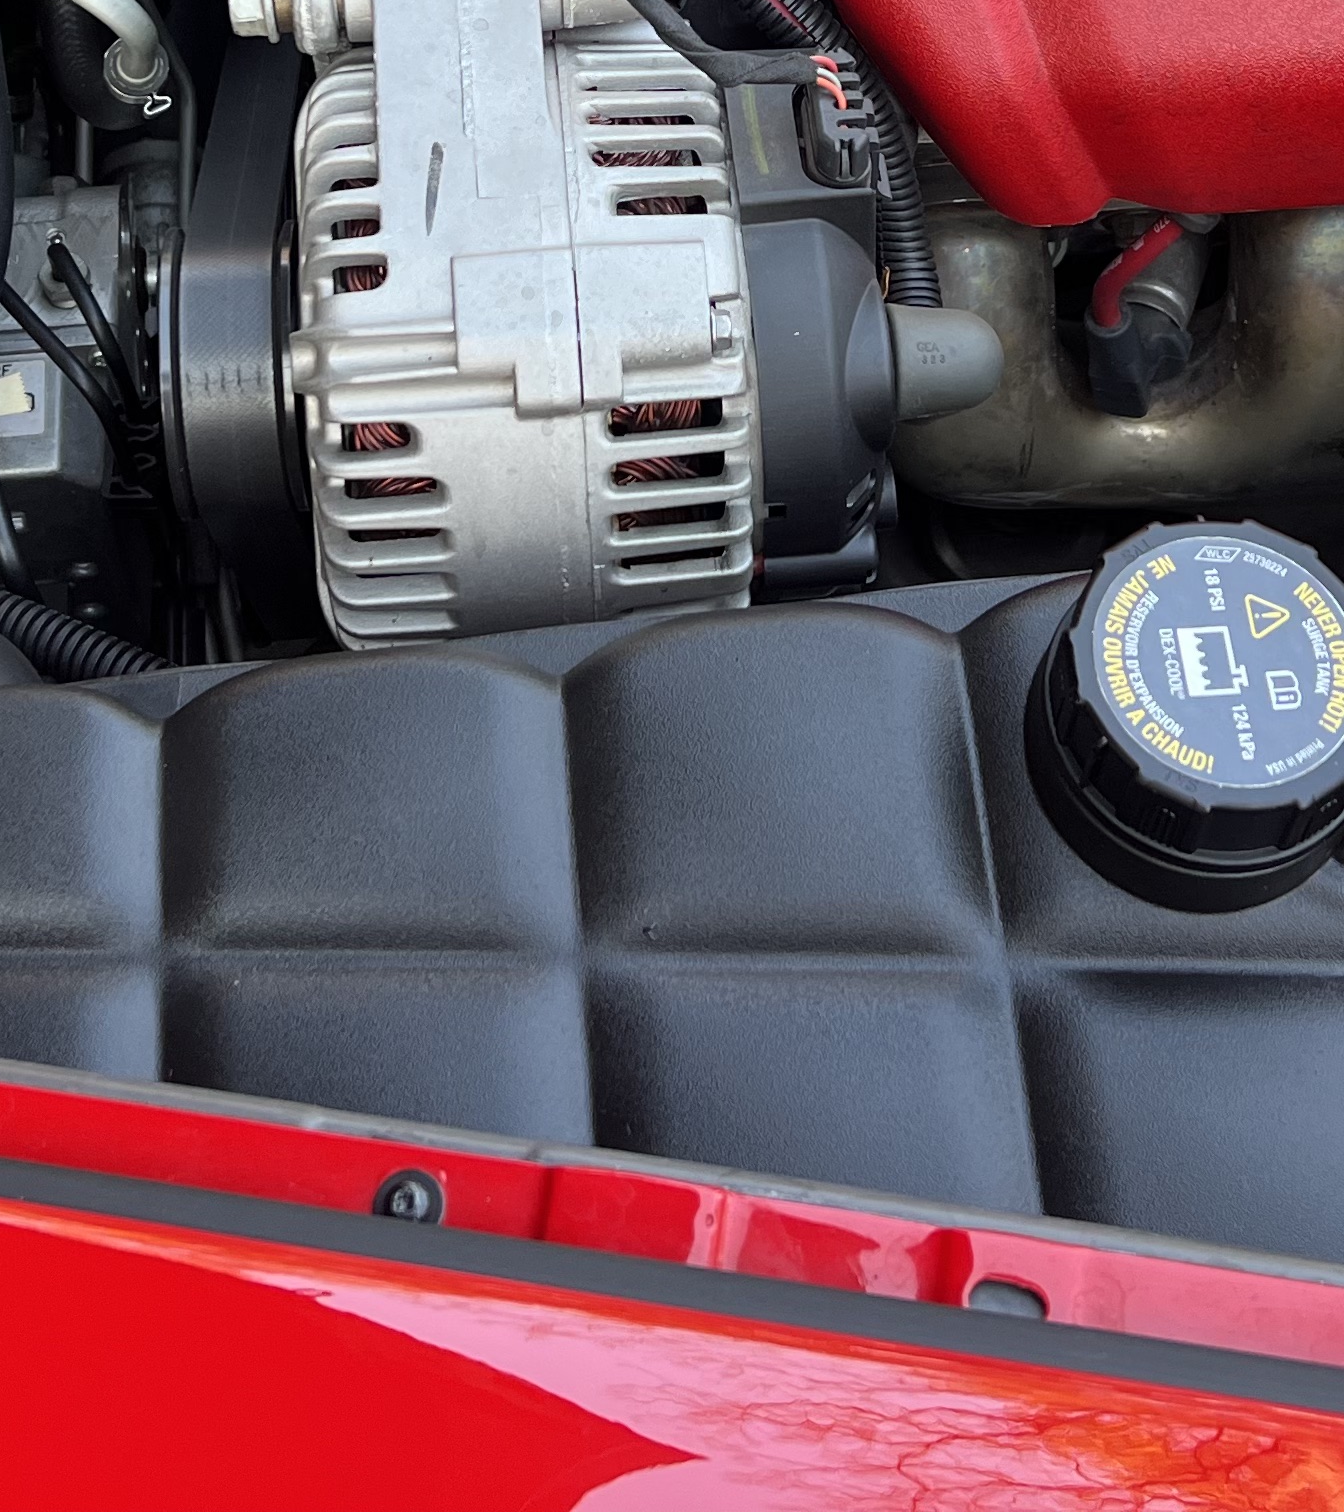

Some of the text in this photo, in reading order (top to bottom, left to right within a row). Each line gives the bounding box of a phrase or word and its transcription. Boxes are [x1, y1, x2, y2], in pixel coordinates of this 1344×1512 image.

[1146, 554, 1177, 580] NE
[1205, 549, 1231, 559] WLC
[1105, 569, 1150, 635] JAMAIS
[1204, 568, 1226, 611] 18 PSI
[1293, 581, 1342, 638] NEVER
[1103, 637, 1136, 708] OUVRIR
[1301, 617, 1331, 696] SURGE TANK
[1125, 659, 1185, 738] D'EXPANSION
[1125, 709, 1145, 726] A
[1141, 722, 1215, 774] CHAUD!
[1232, 704, 1256, 761] 124 kPa
[1295, 737, 1325, 763] Printed
[1265, 760, 1287, 776] USA
